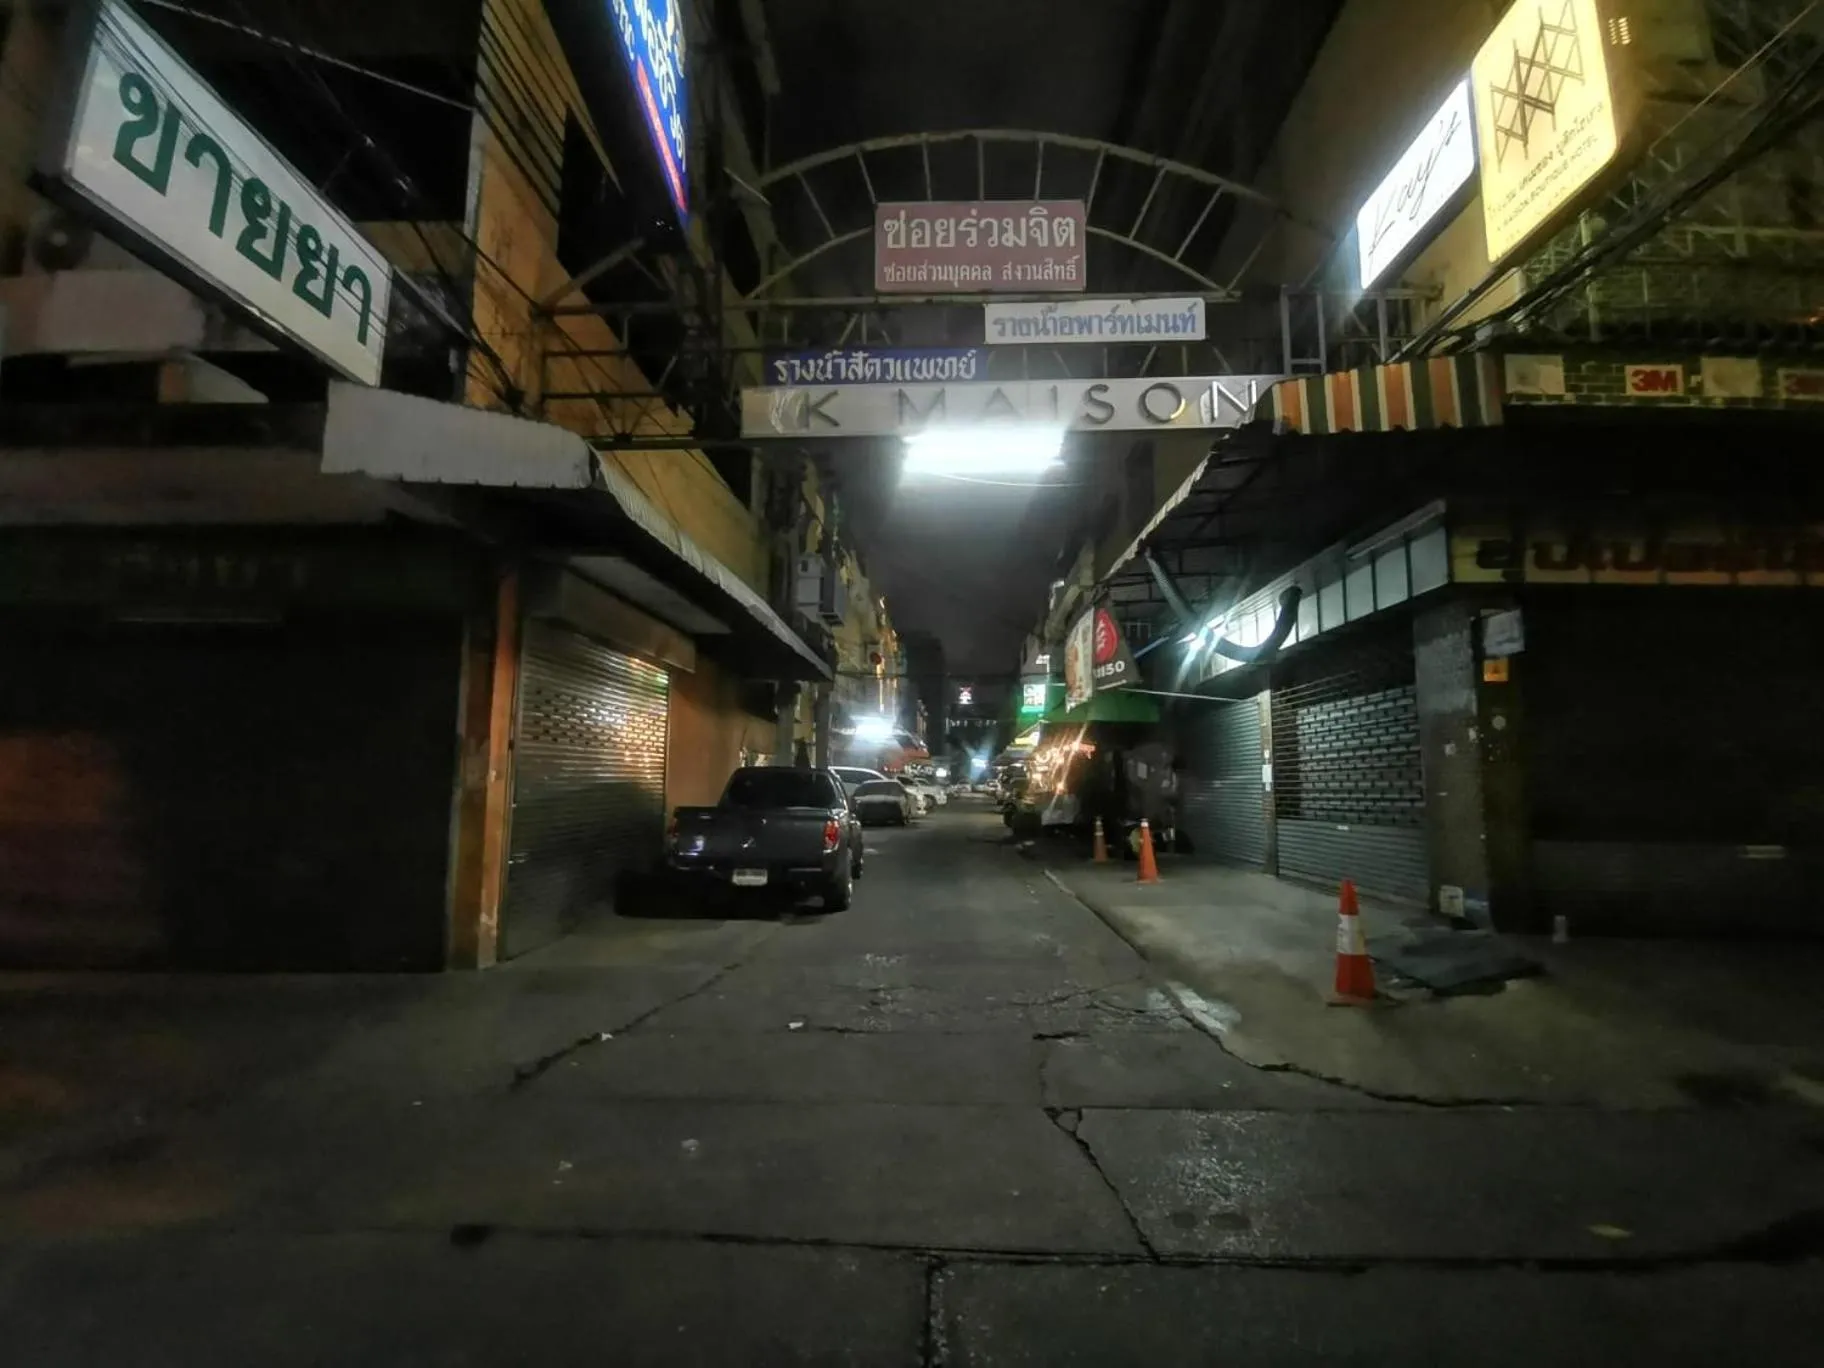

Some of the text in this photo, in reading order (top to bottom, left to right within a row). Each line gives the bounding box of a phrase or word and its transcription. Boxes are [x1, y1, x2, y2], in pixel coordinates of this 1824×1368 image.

[112, 72, 372, 346] ขายยา
[883, 206, 1076, 249] ซอยร่วมจิต
[884, 255, 1080, 288] ซอยส่วนบุคคล สงวนสิทธิ์
[1631, 369, 1677, 392] 3M
[896, 379, 1257, 426] MAISON
